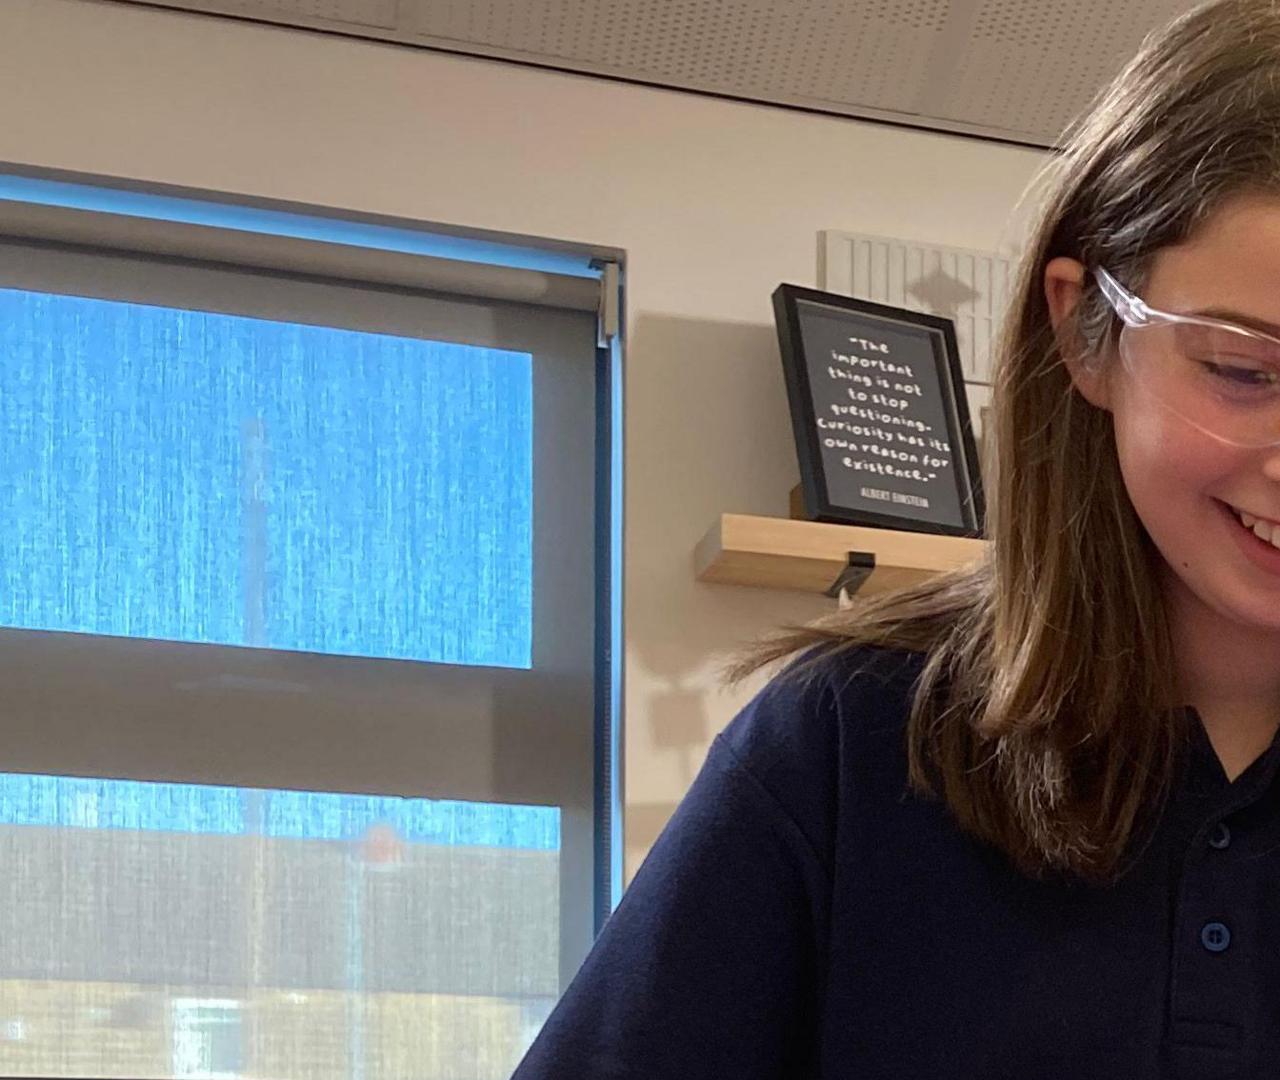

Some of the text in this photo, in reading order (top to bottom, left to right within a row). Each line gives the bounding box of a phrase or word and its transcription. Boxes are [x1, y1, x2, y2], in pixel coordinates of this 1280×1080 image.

[831, 349, 914, 378] important
[827, 366, 923, 397] thing is not
[848, 387, 909, 411] to stop
[831, 403, 932, 433] questioning.
[816, 417, 951, 452] Curiosity has its
[824, 438, 950, 468] own reason for
